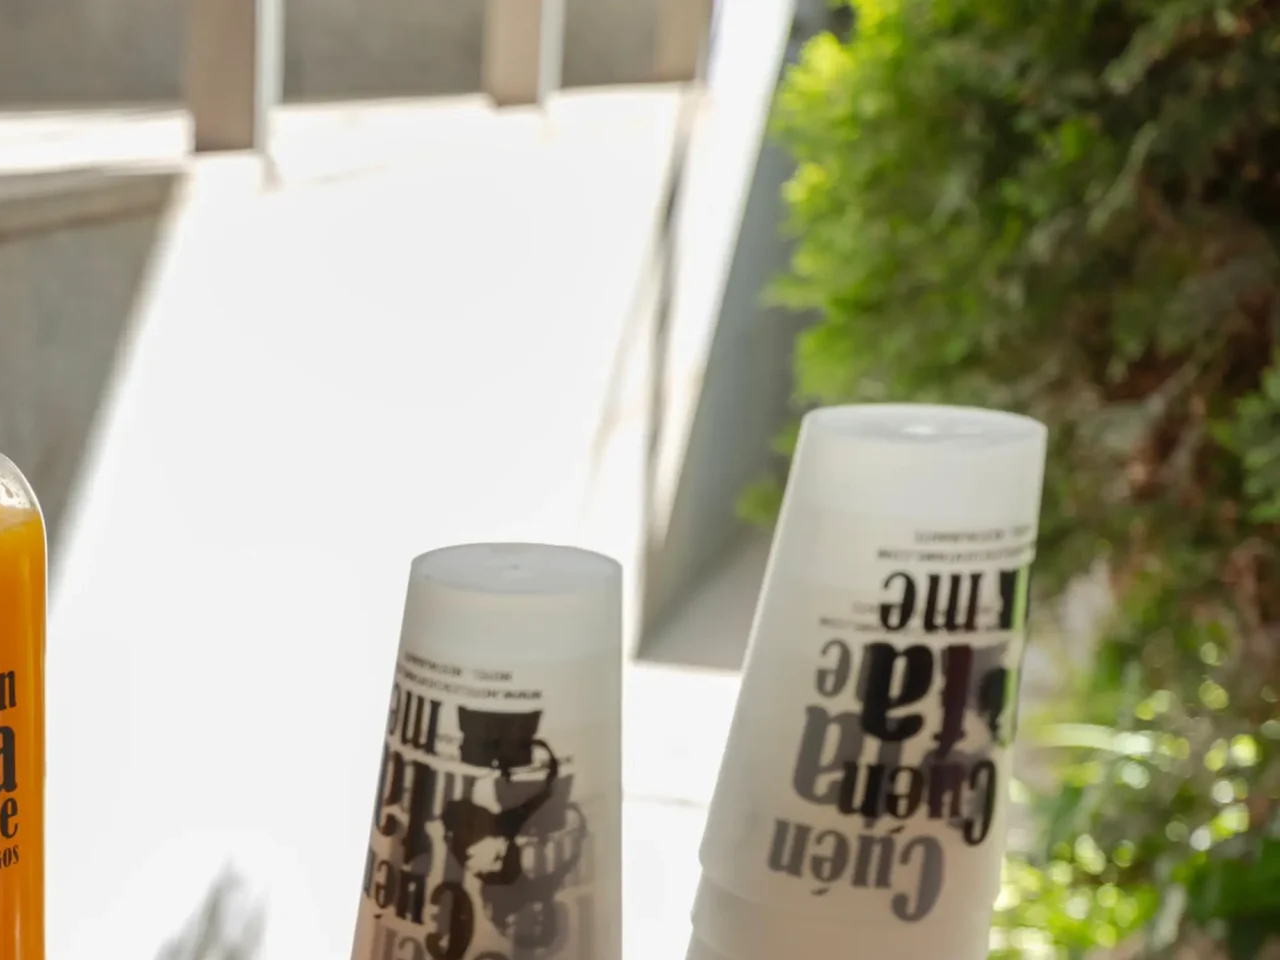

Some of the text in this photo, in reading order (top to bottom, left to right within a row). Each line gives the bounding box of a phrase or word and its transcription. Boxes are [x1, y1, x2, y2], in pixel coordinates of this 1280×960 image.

[879, 571, 982, 634] me
[861, 643, 972, 760] ta
[838, 761, 996, 847] Cuén
[767, 819, 944, 923] Cuén
